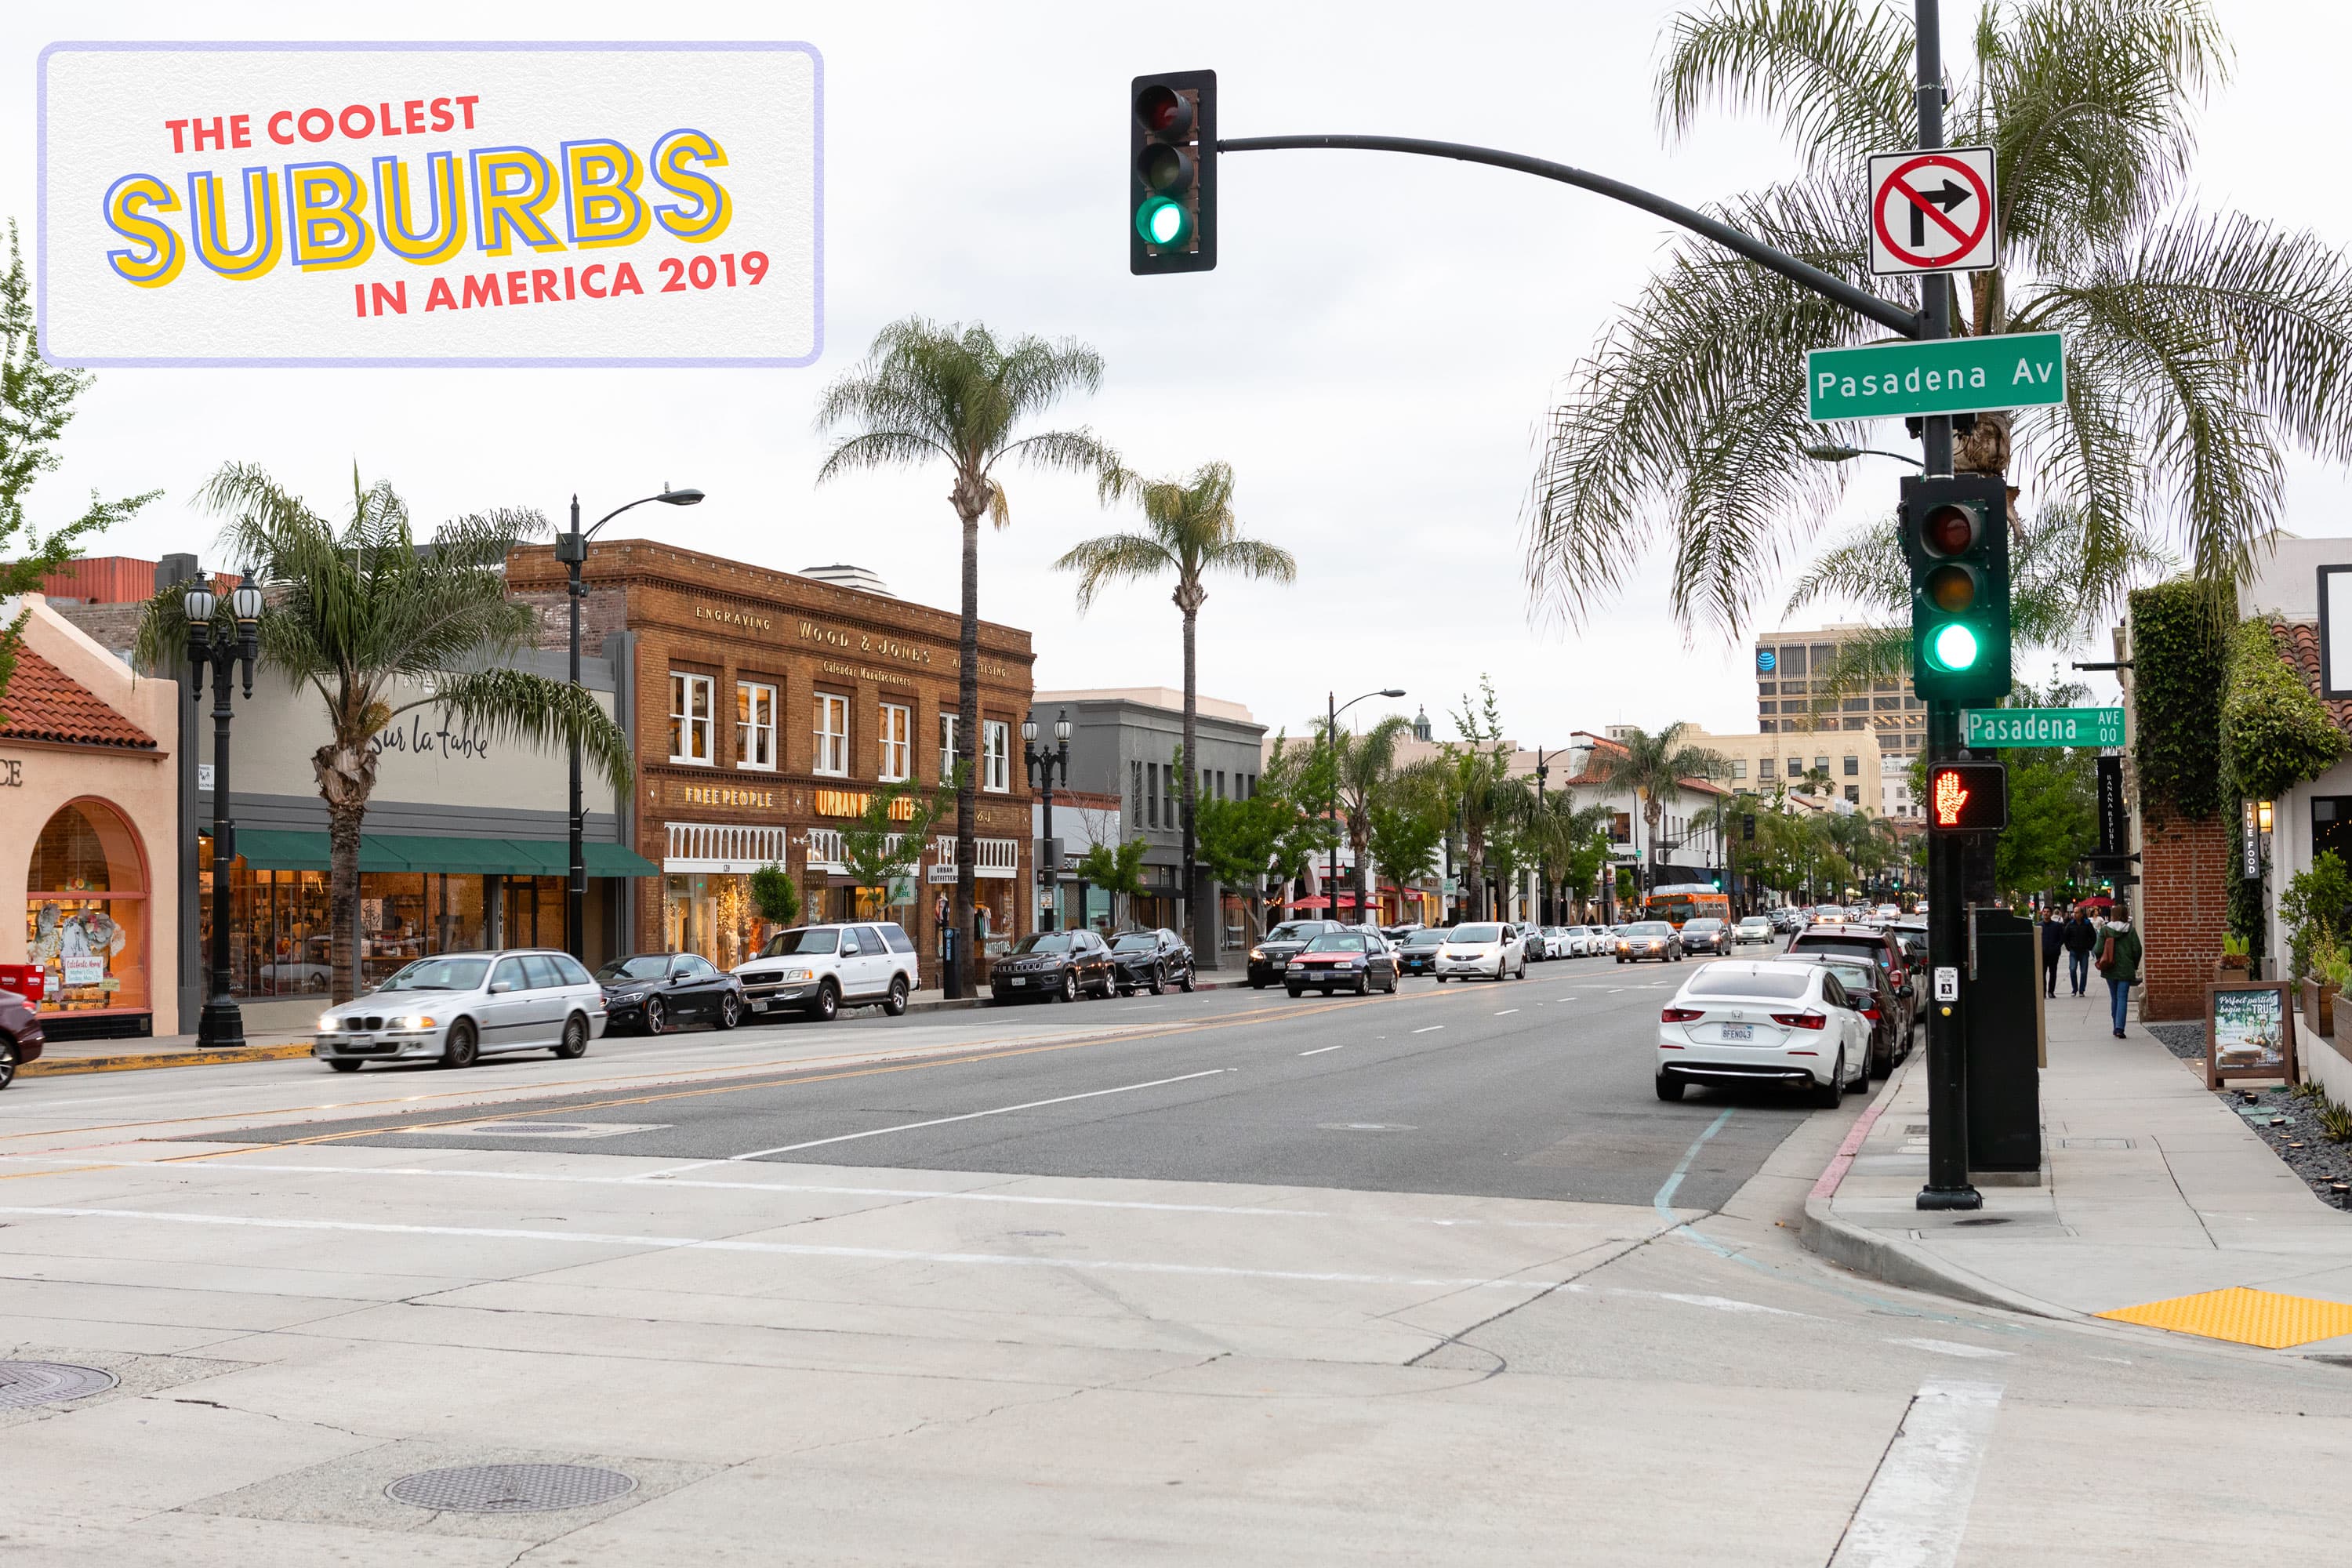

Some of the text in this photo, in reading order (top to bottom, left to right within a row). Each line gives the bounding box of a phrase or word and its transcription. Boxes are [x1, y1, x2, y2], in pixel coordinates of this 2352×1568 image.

[1818, 358, 2053, 399] Pasadena Av
[696, 607, 770, 630] ENGRAVING
[861, 636, 870, 652] &
[878, 640, 931, 663] JONES
[823, 660, 910, 687] Calendar Manufacturers
[1969, 713, 2077, 740] Pasadena
[2098, 711, 2120, 725] AVE
[413, 714, 434, 753] la
[685, 787, 773, 807] FREE PEOPLE
[816, 790, 858, 818] URBAN
[2247, 841, 2256, 874] FOOD
[2219, 996, 2274, 1006] Perfect parties
[2220, 1004, 2241, 1015] begin
[2252, 1004, 2274, 1014] TRUE
